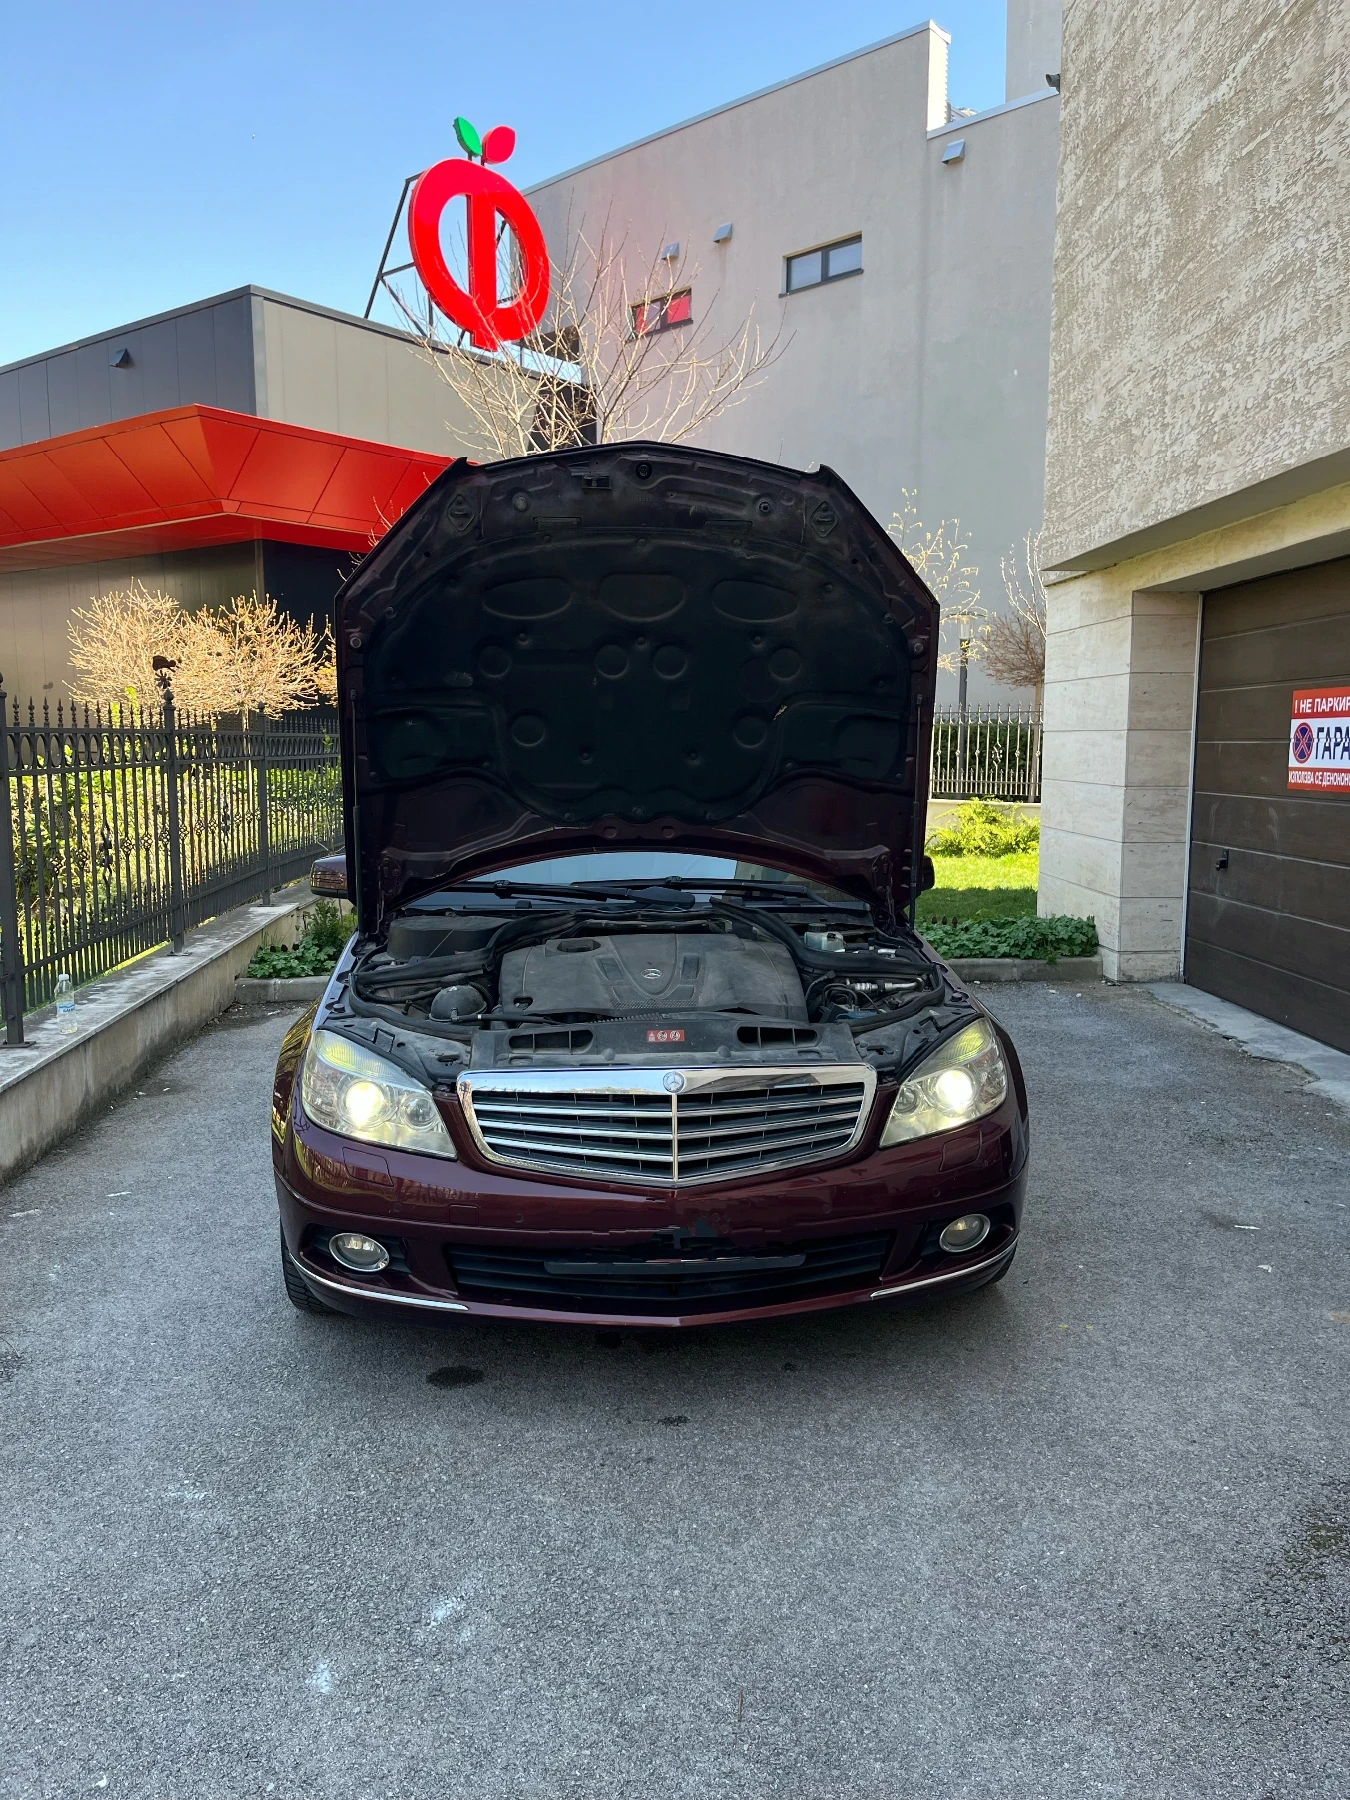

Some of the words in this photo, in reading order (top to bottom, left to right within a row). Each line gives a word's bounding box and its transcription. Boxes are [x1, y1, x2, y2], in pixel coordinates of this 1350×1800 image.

[1300, 699, 1312, 713] НЕ
[1316, 727, 1350, 760] ГАРА
[1315, 772, 1322, 785] СЕ
